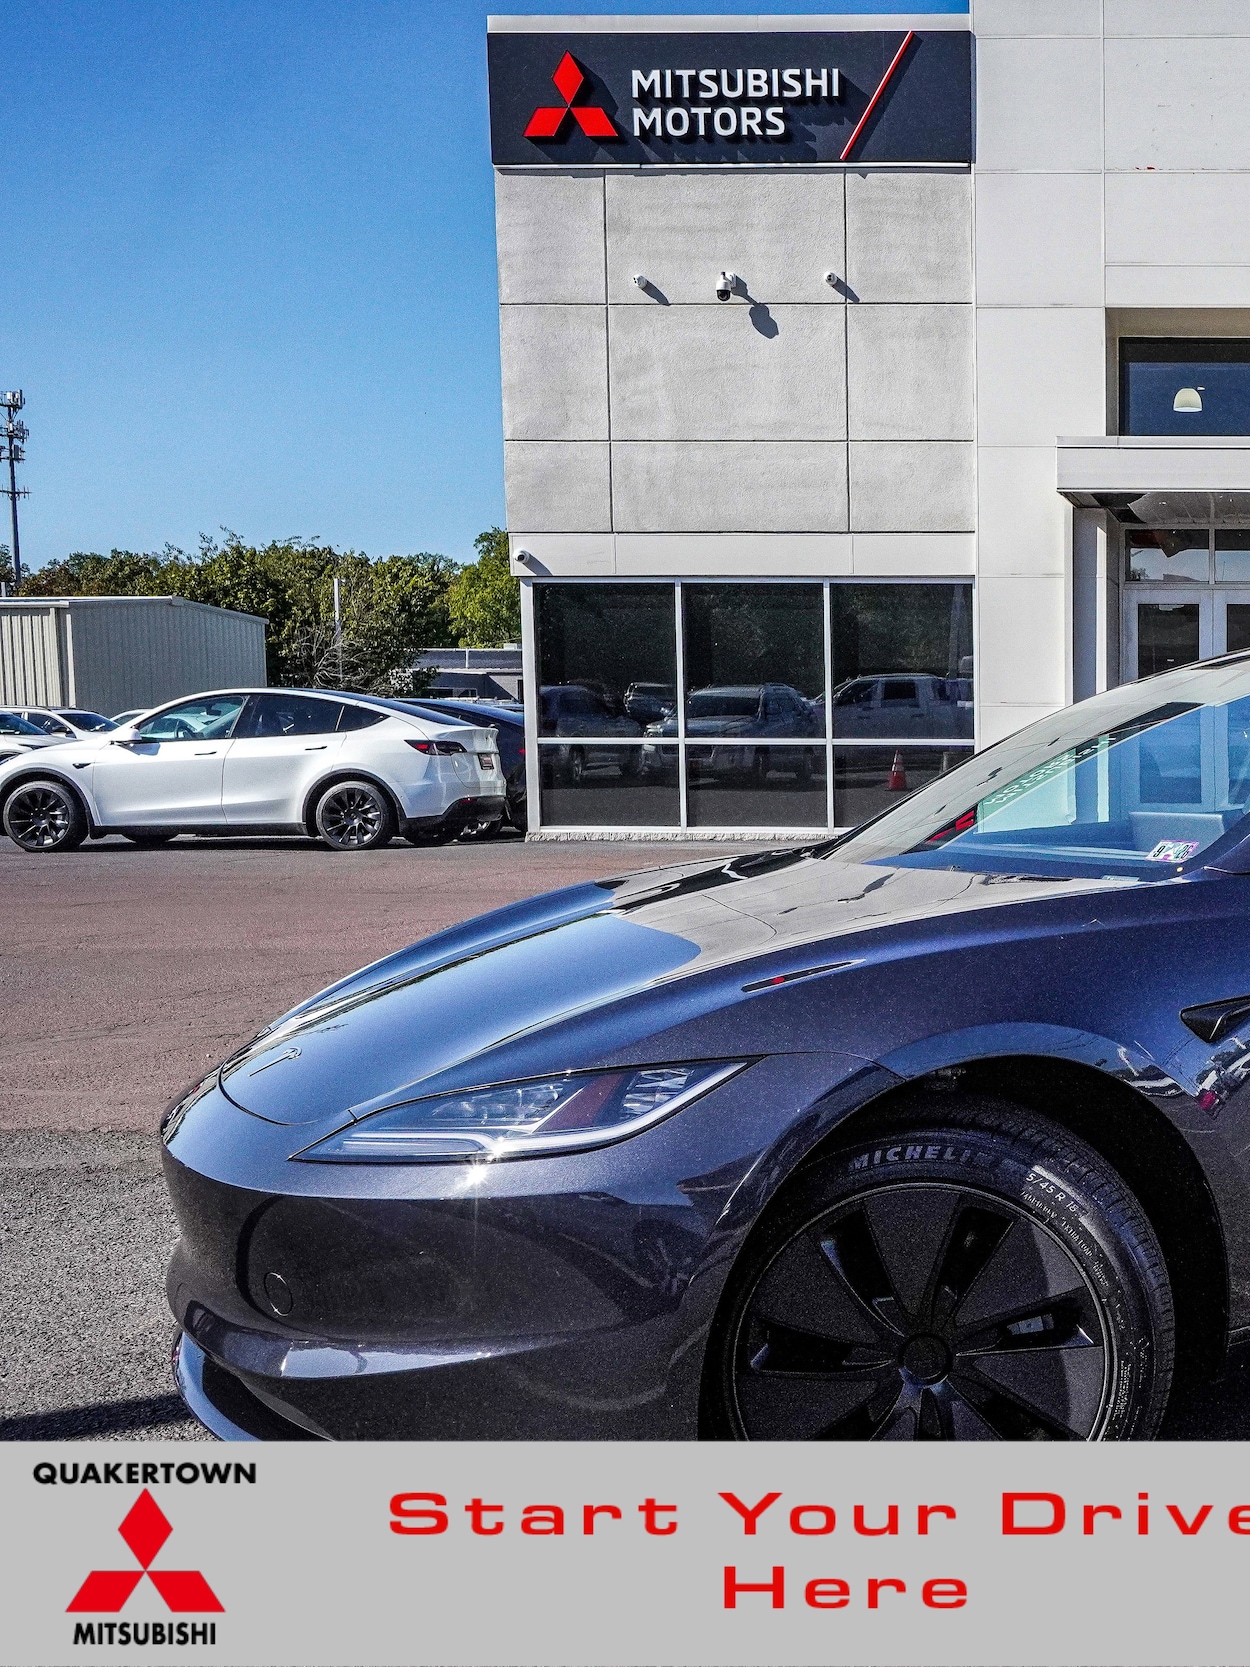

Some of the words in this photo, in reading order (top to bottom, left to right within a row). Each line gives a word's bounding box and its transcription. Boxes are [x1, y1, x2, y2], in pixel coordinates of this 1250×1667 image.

[631, 68, 840, 99] MITSUBISHI
[632, 106, 785, 138] MOTORS
[1153, 845, 1166, 858] 9
